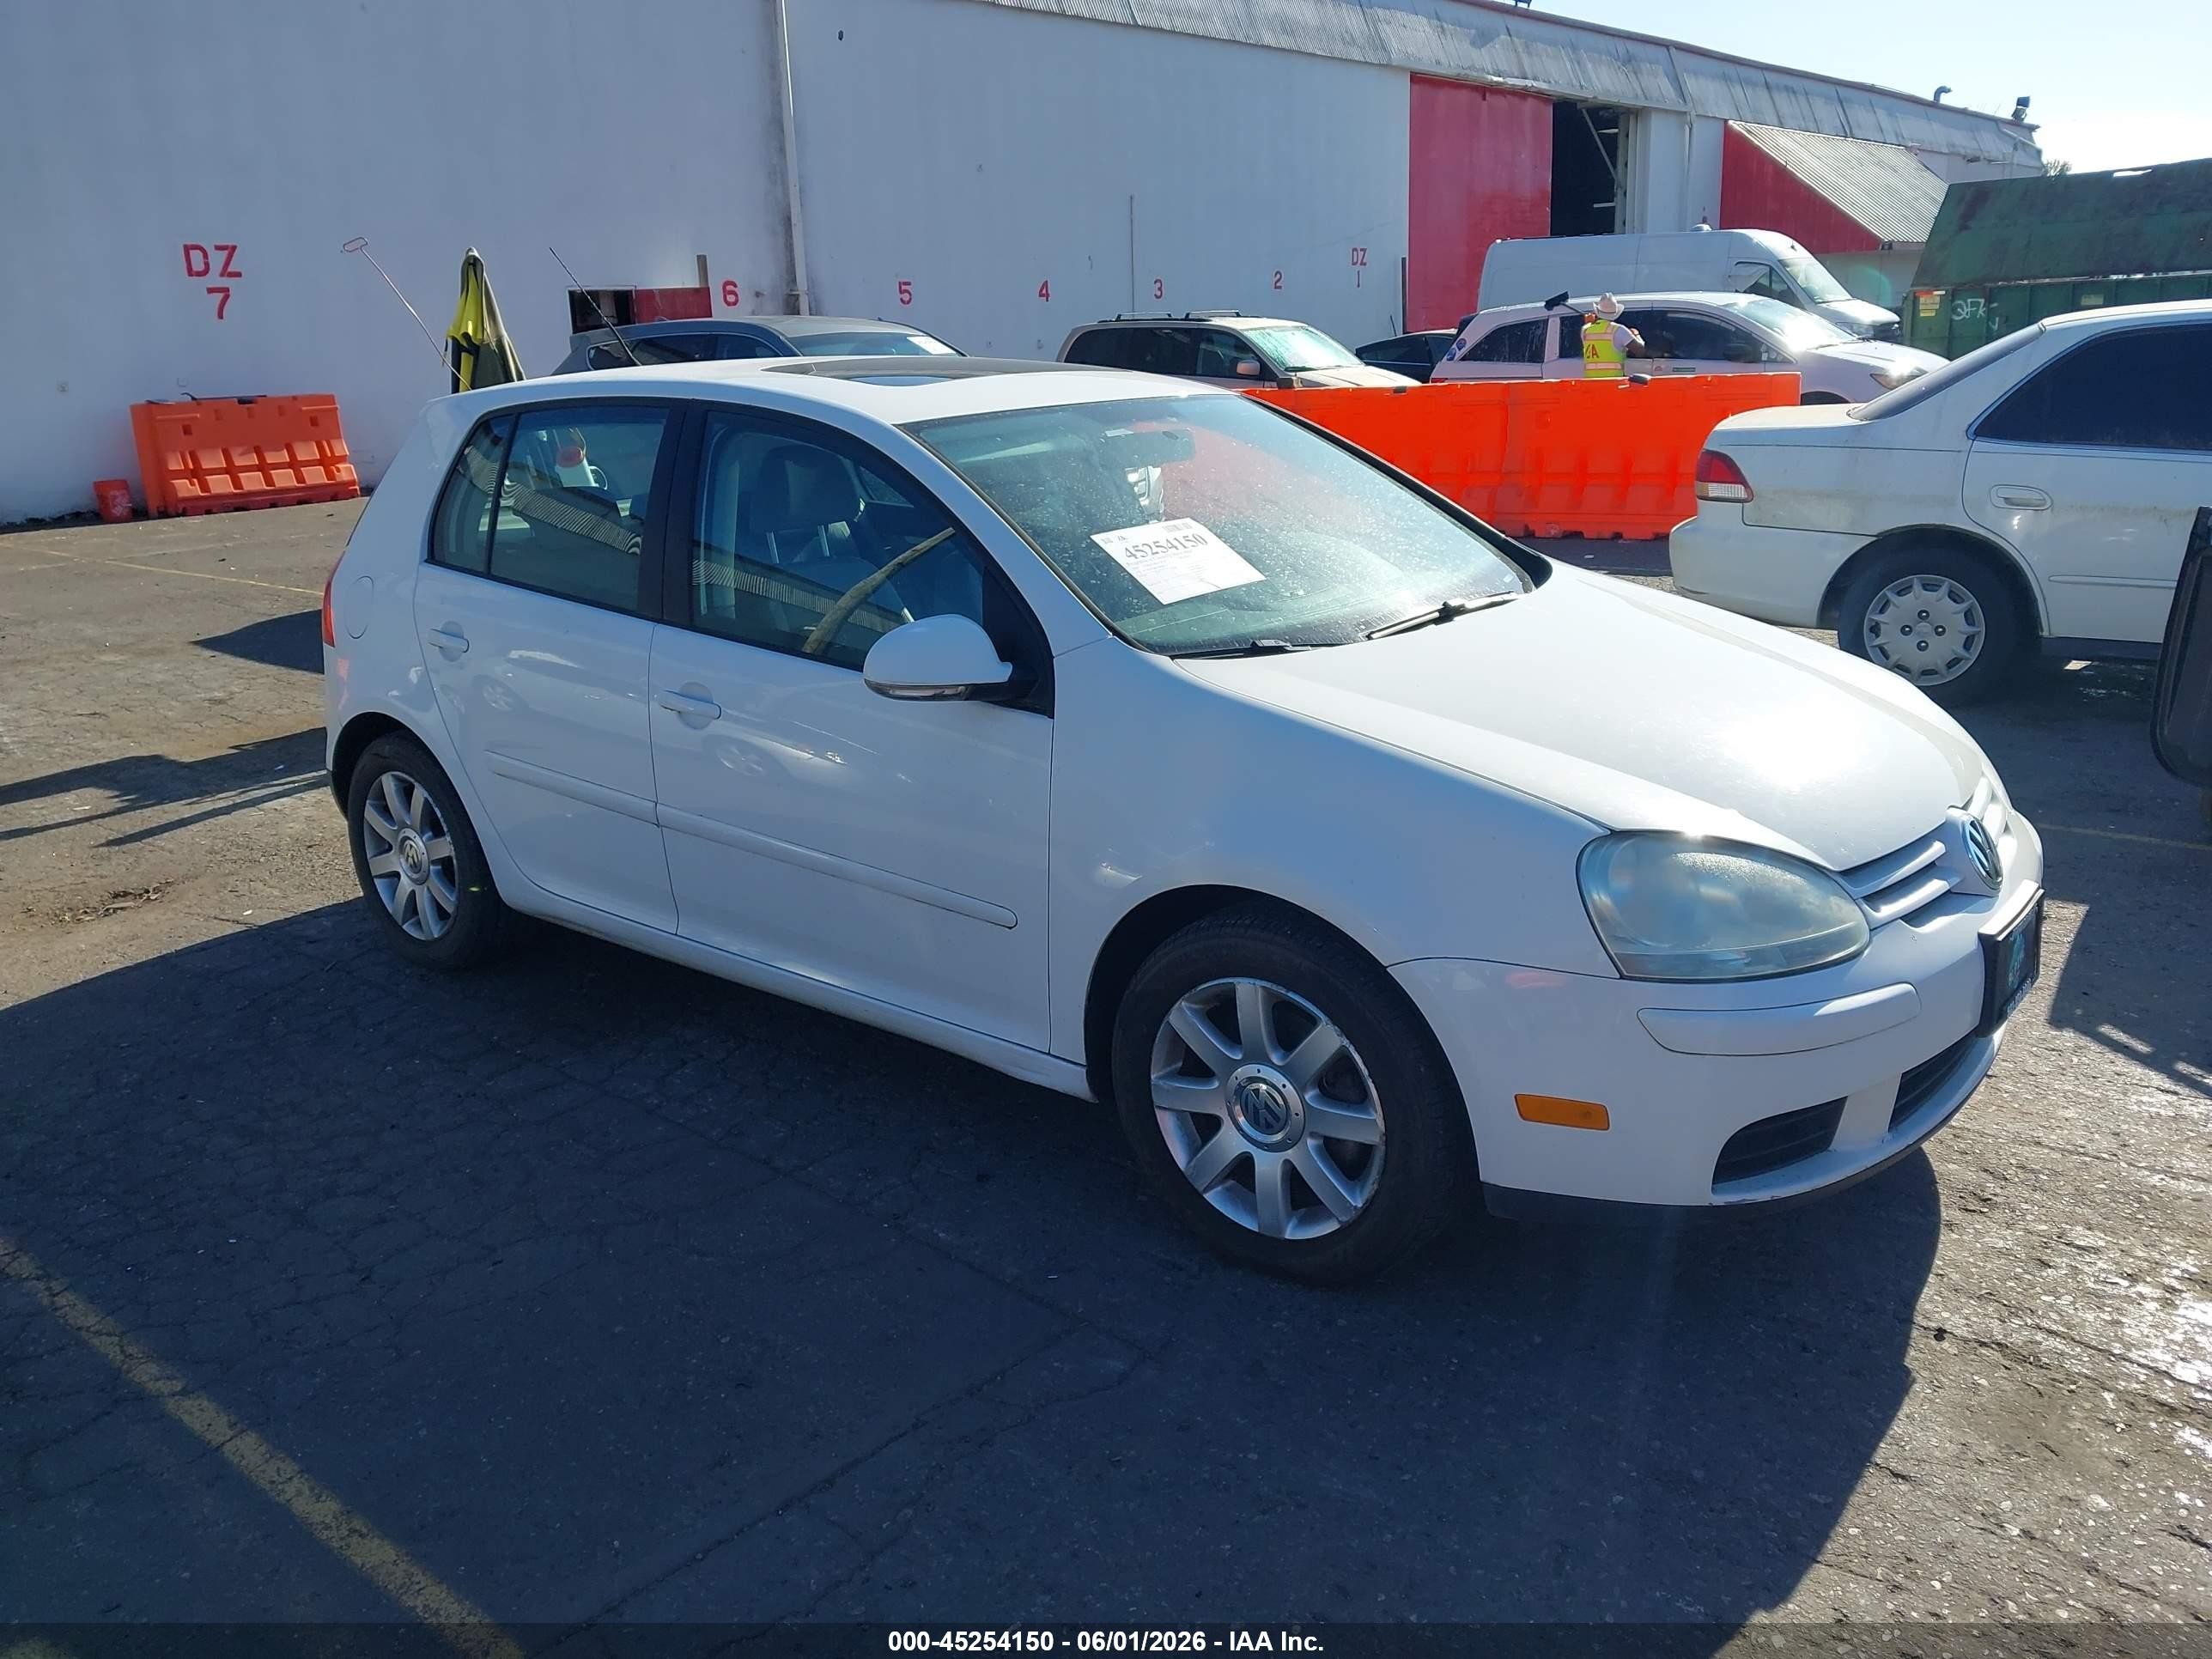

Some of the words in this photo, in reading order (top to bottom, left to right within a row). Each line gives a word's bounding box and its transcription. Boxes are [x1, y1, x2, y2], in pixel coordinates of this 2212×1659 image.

[182, 243, 243, 278] DZ
[1351, 246, 1368, 266] DZ
[1037, 280, 1050, 302] 4
[1153, 278, 1164, 300] 3
[1273, 270, 1284, 290] 2
[206, 286, 230, 320] 7
[721, 280, 739, 307] 6
[898, 281, 912, 305] 5
[1123, 532, 1209, 560] 45254150
